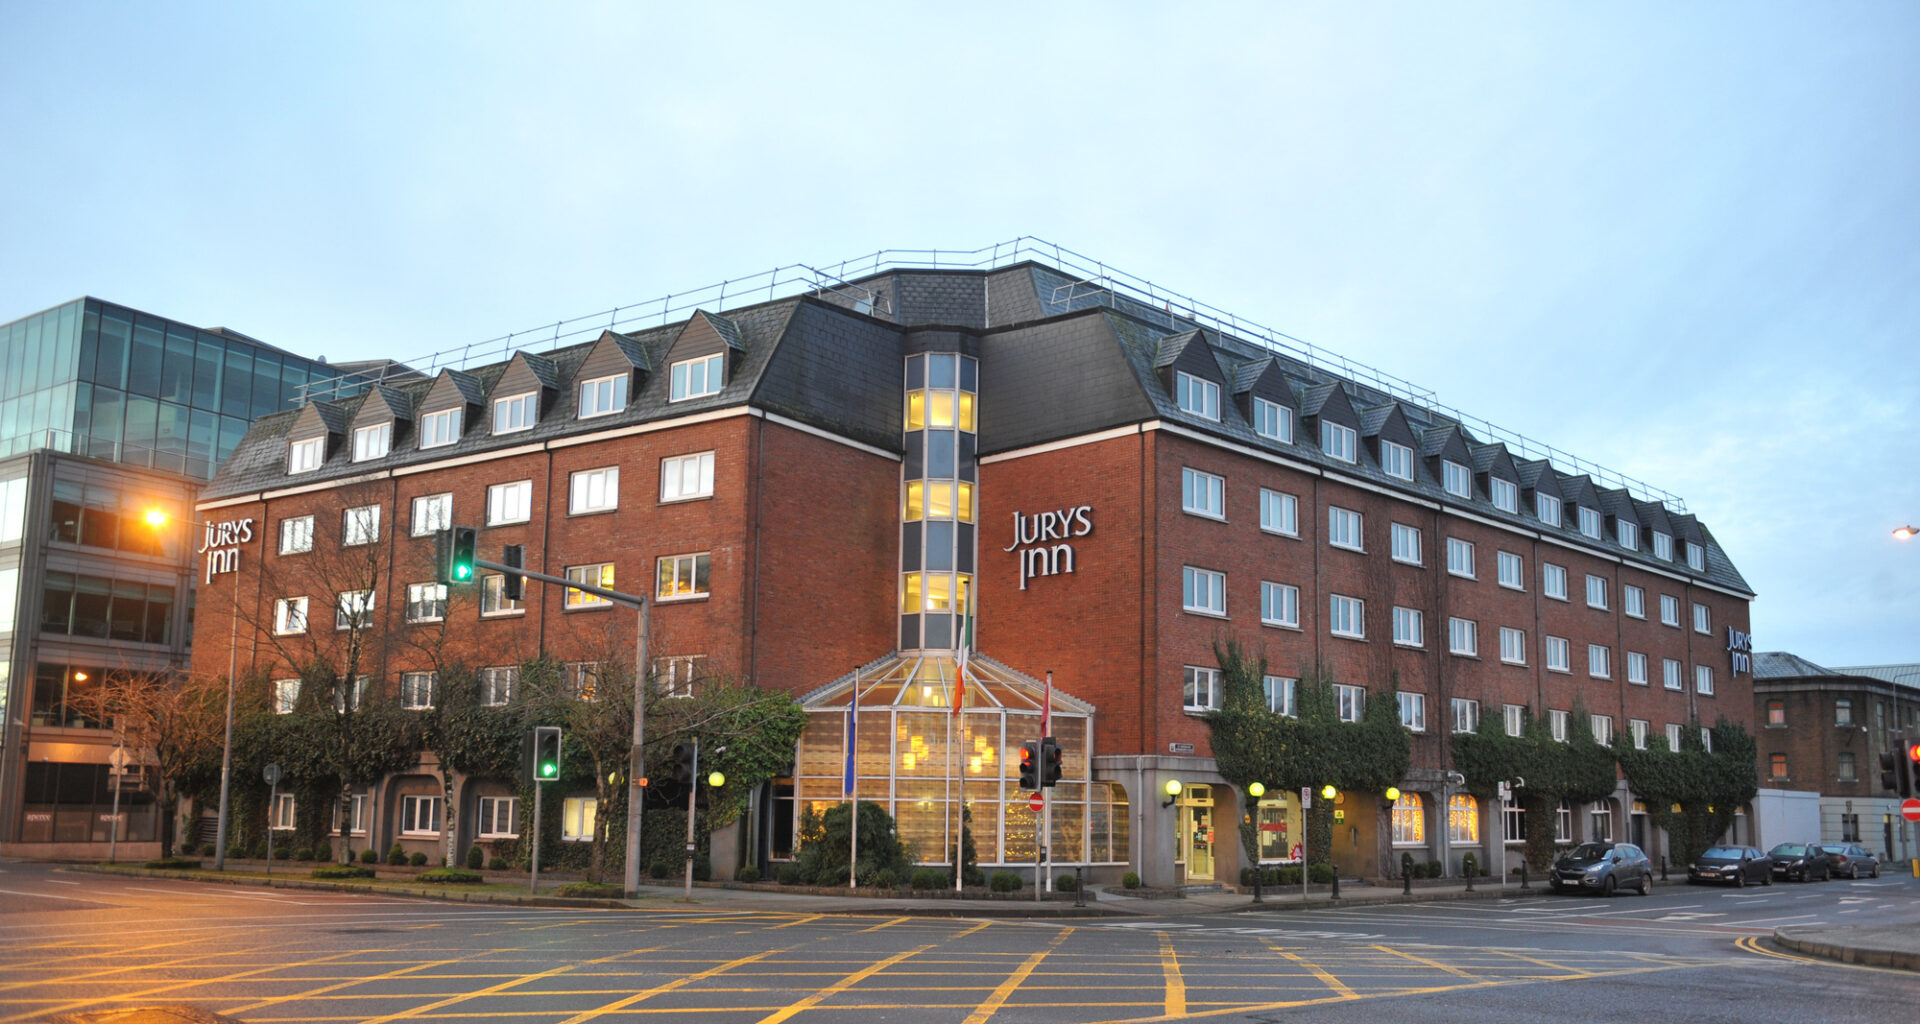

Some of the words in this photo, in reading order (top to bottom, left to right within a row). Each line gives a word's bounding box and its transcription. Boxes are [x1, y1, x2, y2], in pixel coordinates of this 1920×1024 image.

[198, 518, 254, 554] JURYS
[1003, 506, 1094, 552] JURYS
[1727, 625, 1753, 652] JURYS
